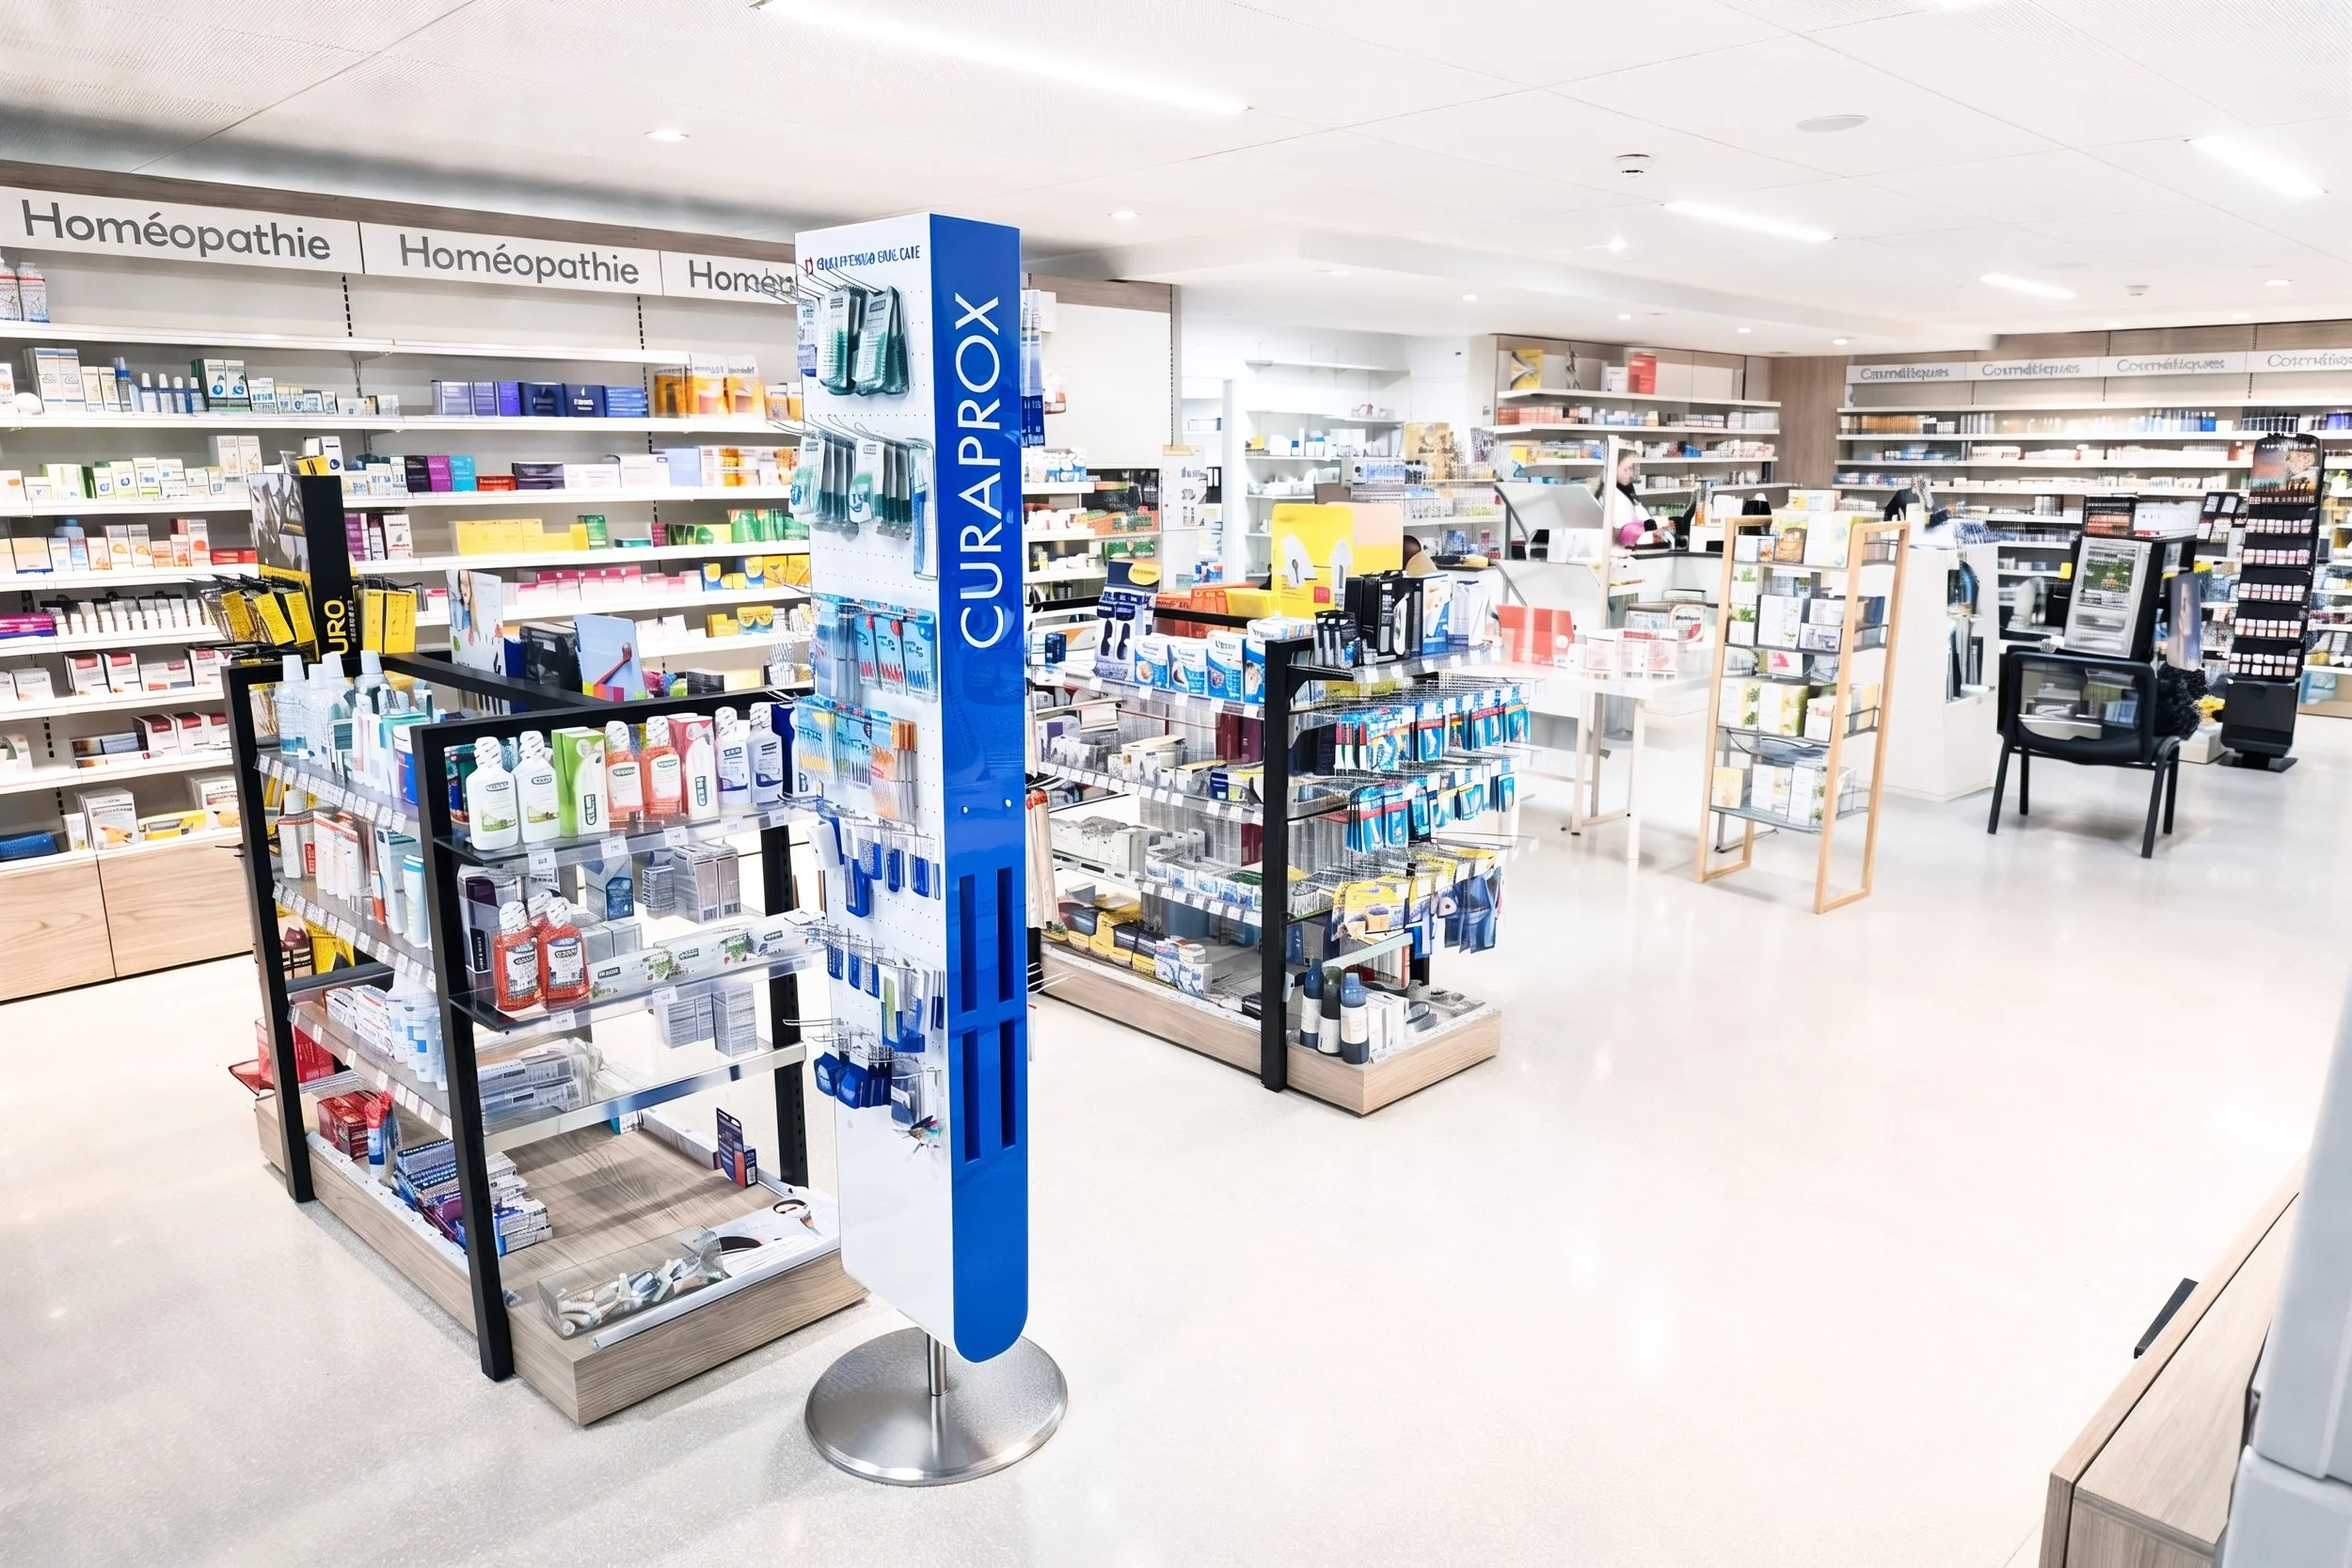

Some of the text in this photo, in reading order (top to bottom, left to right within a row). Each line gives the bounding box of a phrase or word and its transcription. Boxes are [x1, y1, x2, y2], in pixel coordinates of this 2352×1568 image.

[22, 199, 330, 260] Homéopathie
[400, 234, 640, 284] Homéopathie
[955, 293, 1004, 648] CURAPROX
